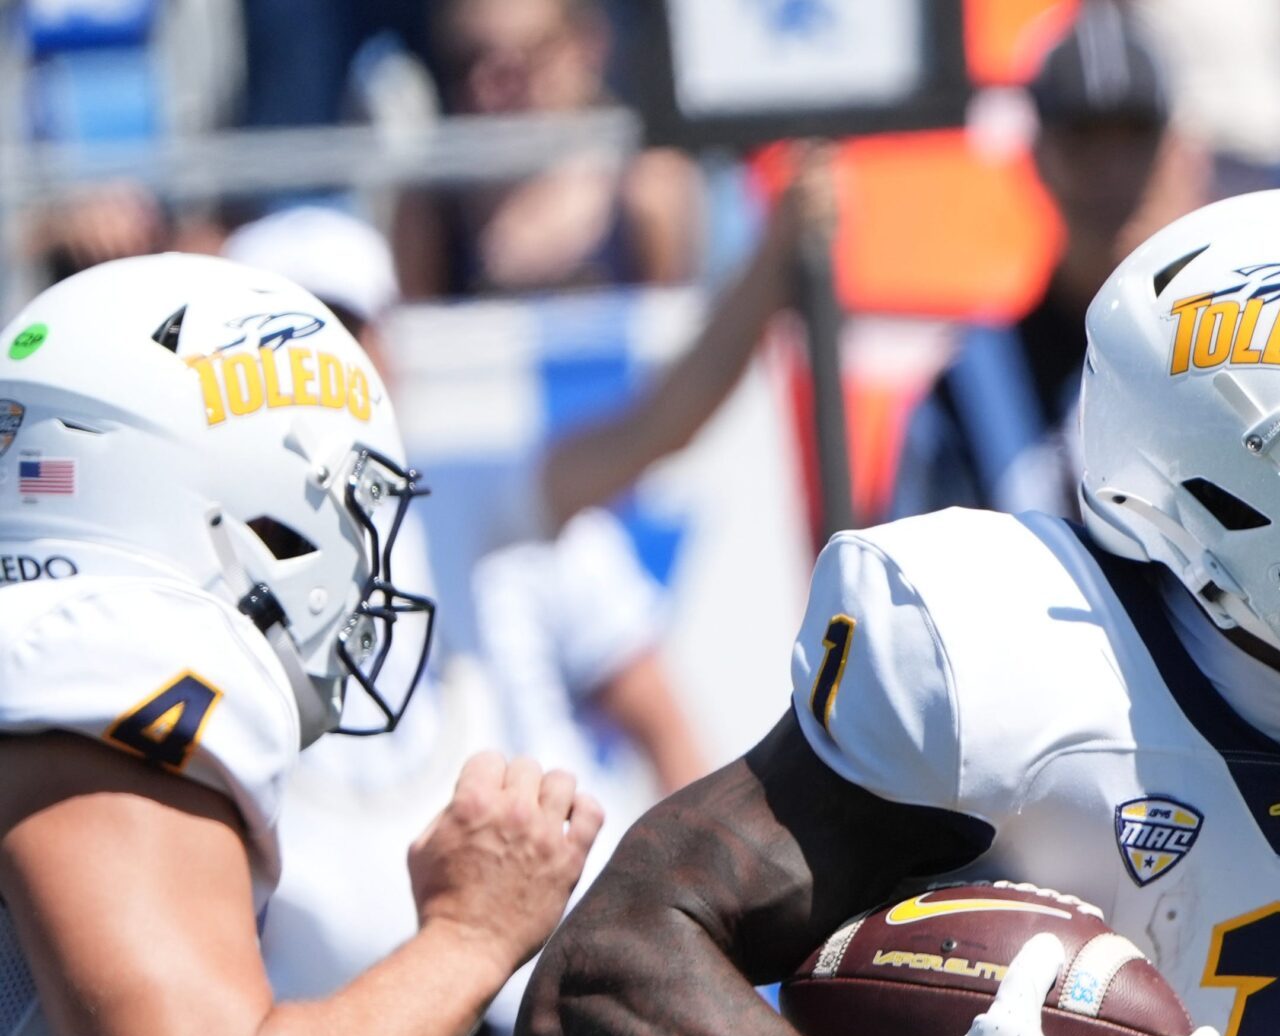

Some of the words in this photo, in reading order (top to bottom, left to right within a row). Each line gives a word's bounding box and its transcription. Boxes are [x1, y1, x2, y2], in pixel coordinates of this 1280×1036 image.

[183, 346, 371, 426] TOLEDO
[0, 555, 78, 582] EDO
[809, 613, 857, 730] 1
[103, 670, 224, 775] 4
[1120, 821, 1194, 852] MAC
